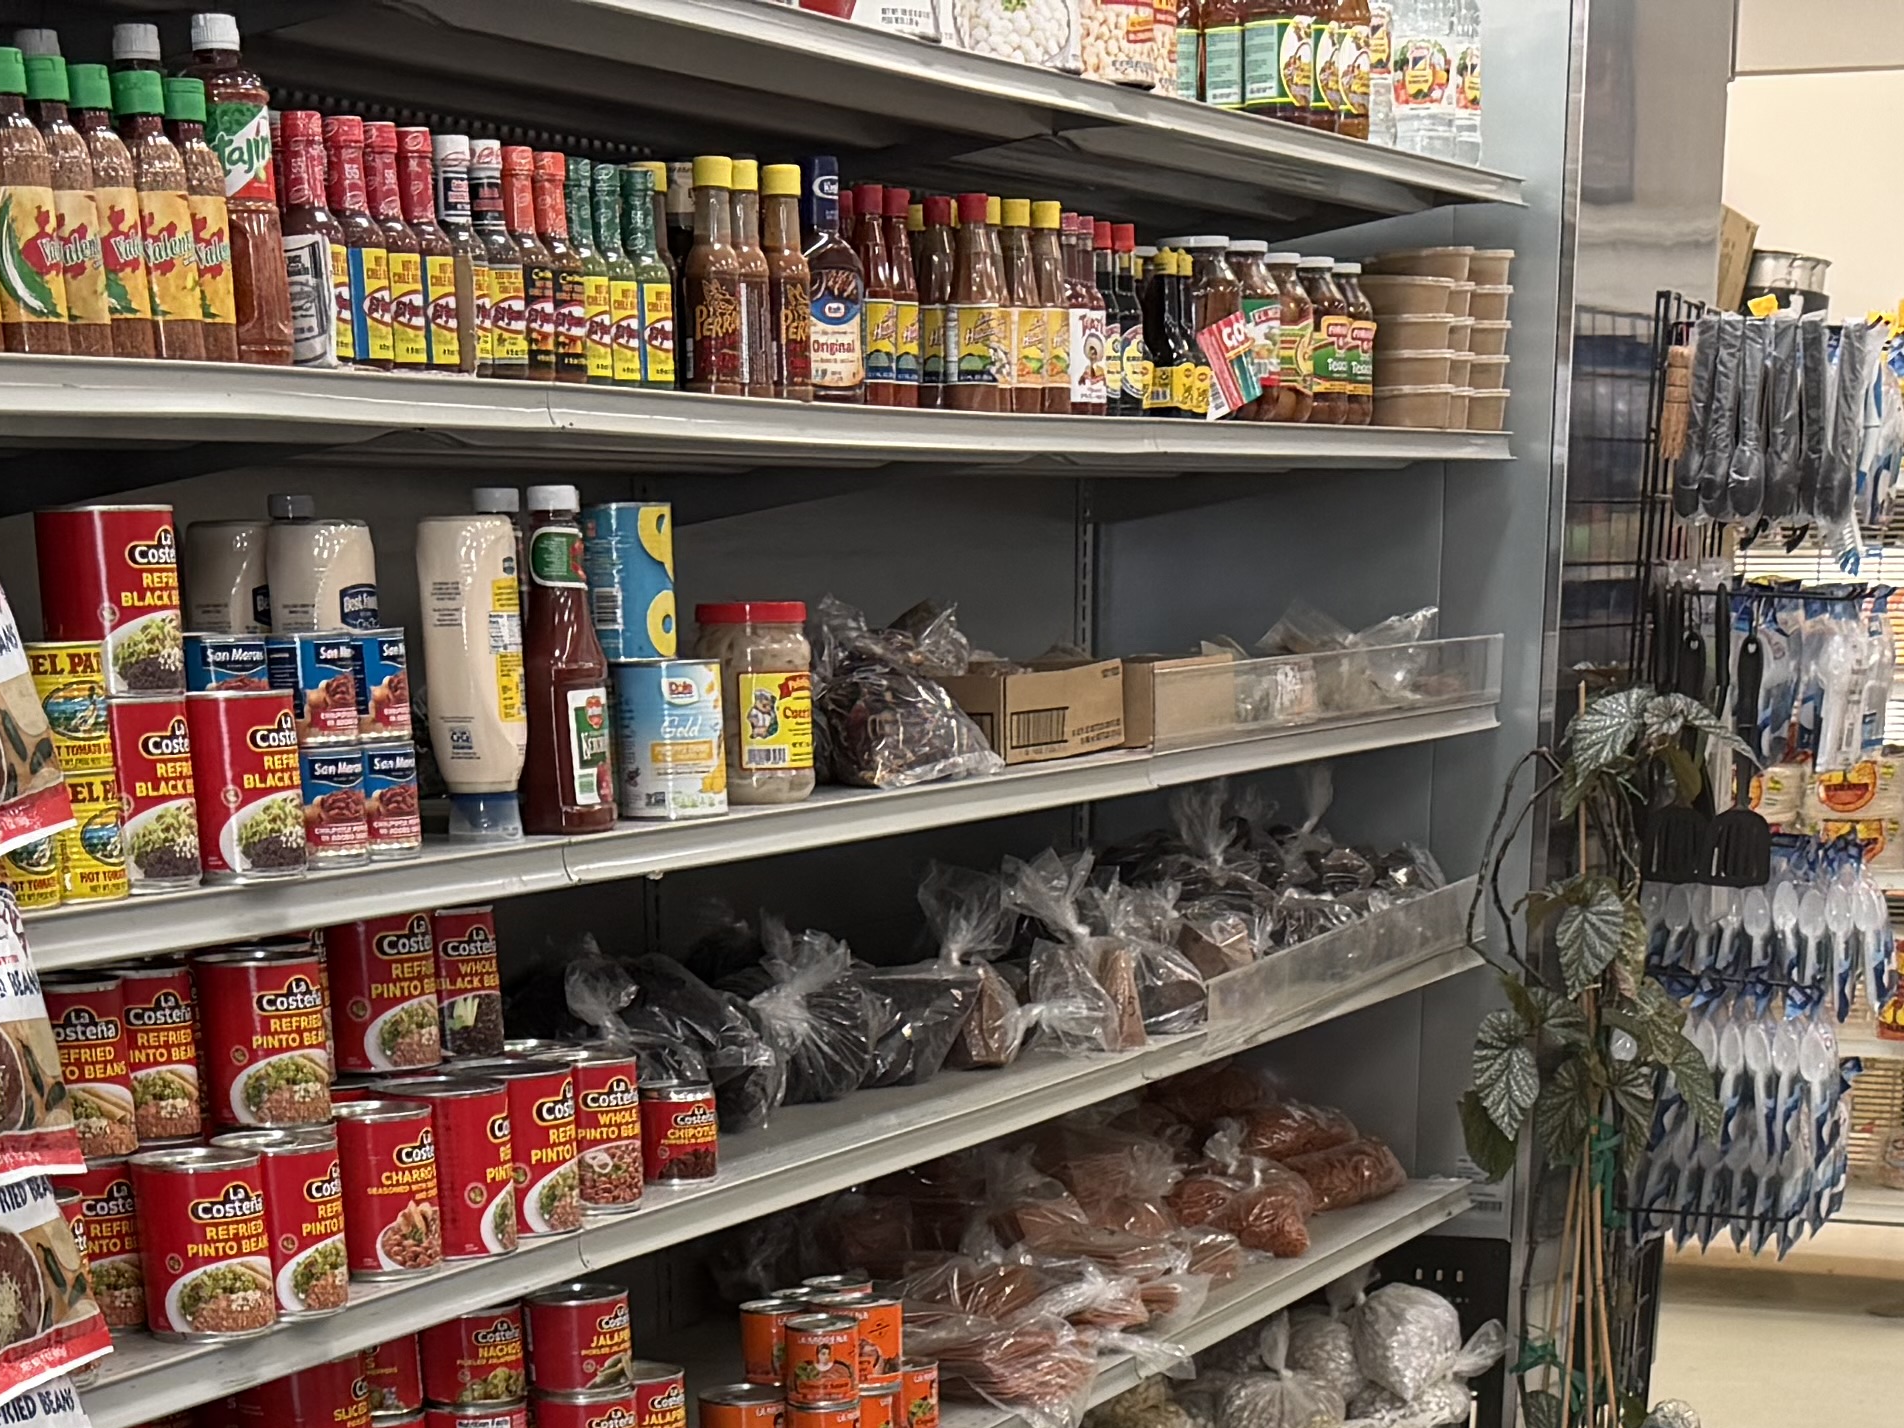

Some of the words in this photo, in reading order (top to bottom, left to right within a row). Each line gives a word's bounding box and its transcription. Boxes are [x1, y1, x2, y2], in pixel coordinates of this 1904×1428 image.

[812, 338, 855, 356] Original
[31, 652, 65, 677] EL
[660, 714, 702, 738] Gold
[243, 773, 292, 790] BLACK
[269, 1008, 322, 1035] REFRIED
[251, 1027, 295, 1051] PINTO
[598, 1109, 637, 1128] WHOLE
[227, 1182, 245, 1199] La
[204, 1219, 260, 1243] REFRIED
[186, 1239, 229, 1258] PINTO
